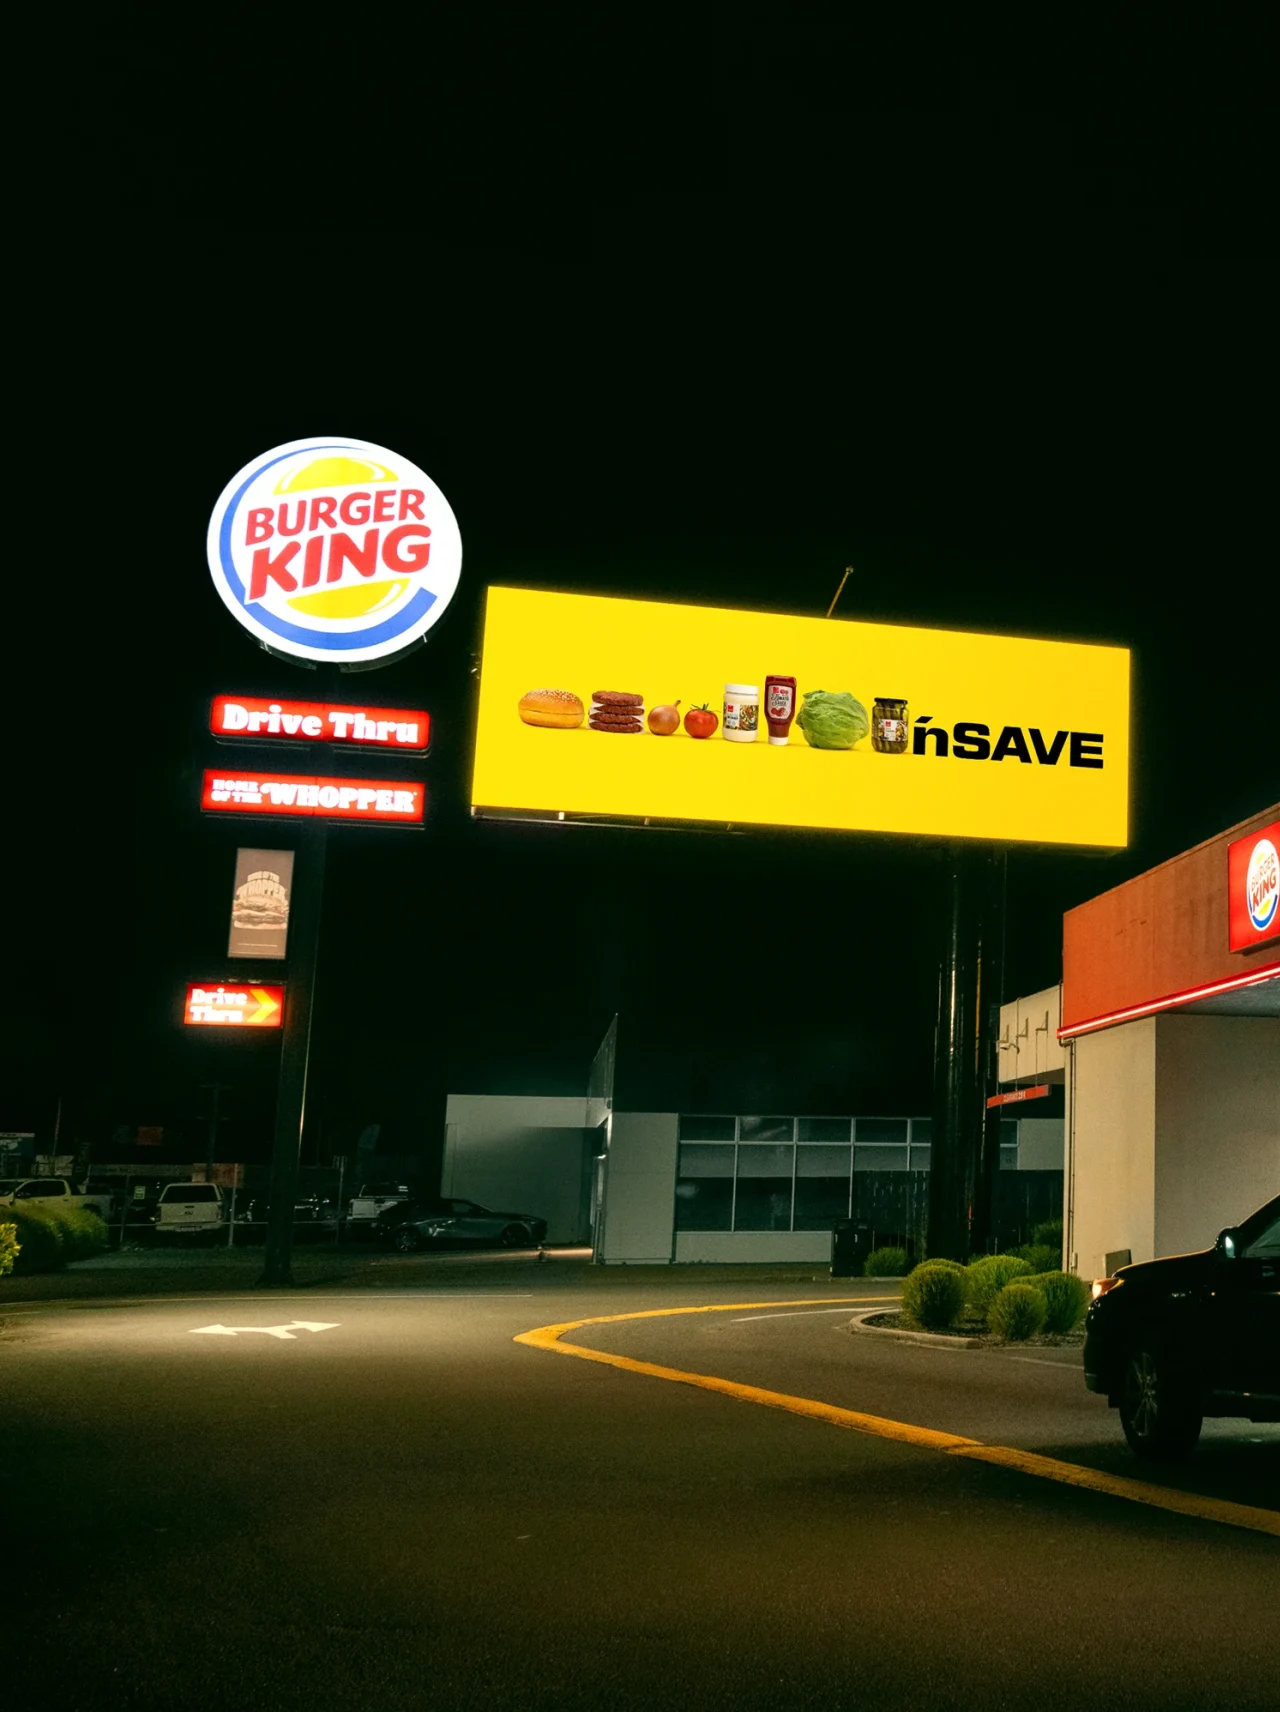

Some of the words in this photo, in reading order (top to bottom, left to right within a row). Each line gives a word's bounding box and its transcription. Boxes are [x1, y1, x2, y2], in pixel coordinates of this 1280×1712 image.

[245, 488, 426, 546] BURGER
[249, 523, 432, 601] KING
[222, 704, 323, 736] Drive
[328, 712, 419, 743] Thru
[212, 779, 259, 792] HOME
[260, 782, 416, 813] WHOPPER
[1252, 867, 1277, 914] KING
[190, 1005, 243, 1023] Thru
[191, 988, 248, 1006] Drive
